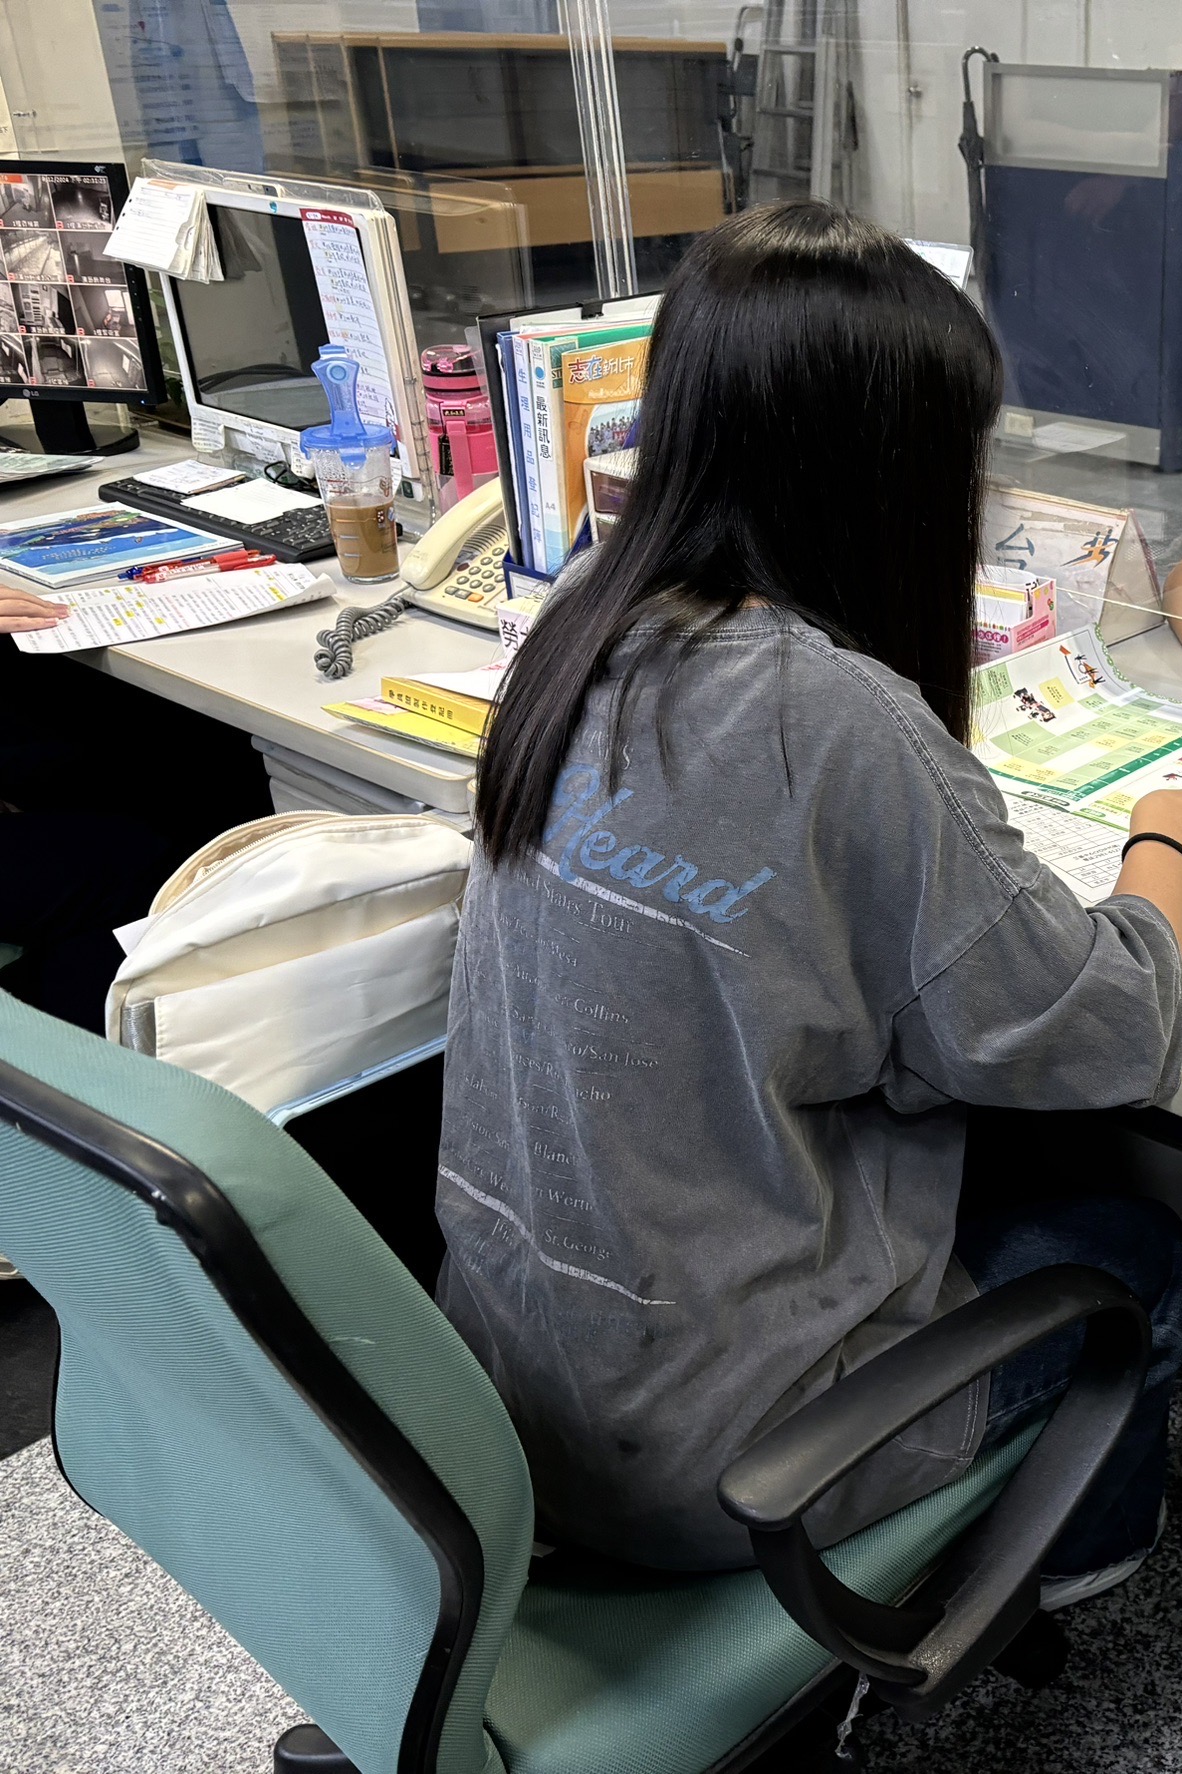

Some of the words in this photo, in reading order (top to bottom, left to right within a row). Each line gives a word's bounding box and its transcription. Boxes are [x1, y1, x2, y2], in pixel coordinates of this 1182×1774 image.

[535, 395, 551, 459] 最新訊息
[545, 502, 556, 511] A4
[543, 764, 777, 924] Heard
[587, 899, 635, 934] Tour
[573, 998, 629, 1024] Collins
